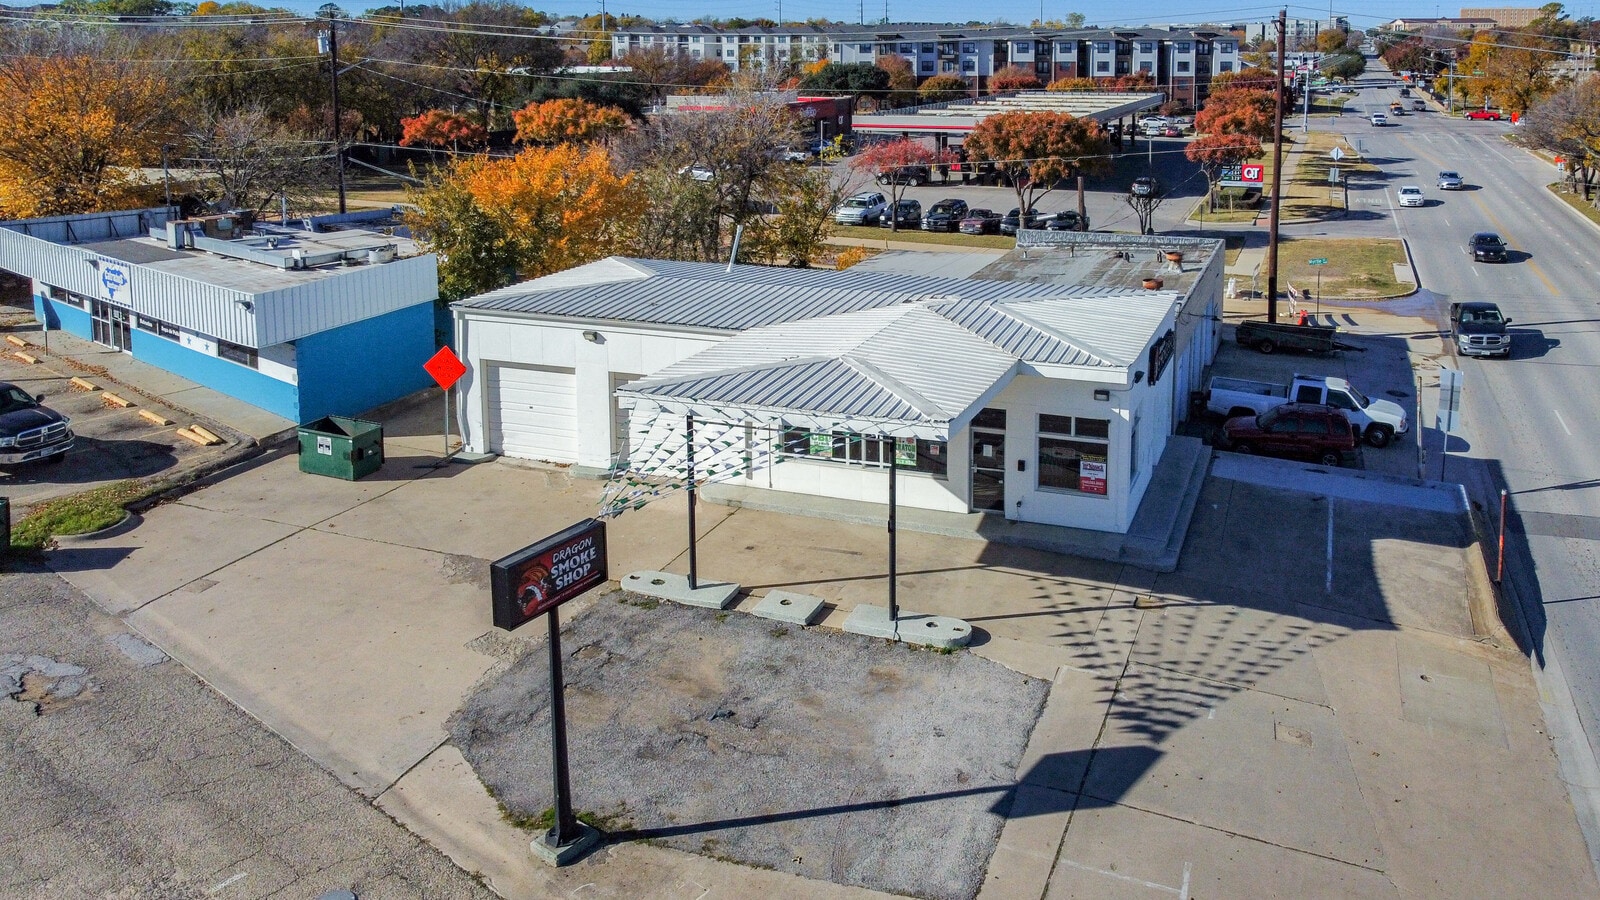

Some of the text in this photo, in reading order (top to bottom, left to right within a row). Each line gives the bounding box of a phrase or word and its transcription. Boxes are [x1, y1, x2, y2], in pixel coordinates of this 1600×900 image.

[1244, 167, 1260, 180] QT
[551, 547, 596, 579] SMOKE
[553, 537, 592, 563] DRAGON
[555, 563, 591, 590] SHOP
